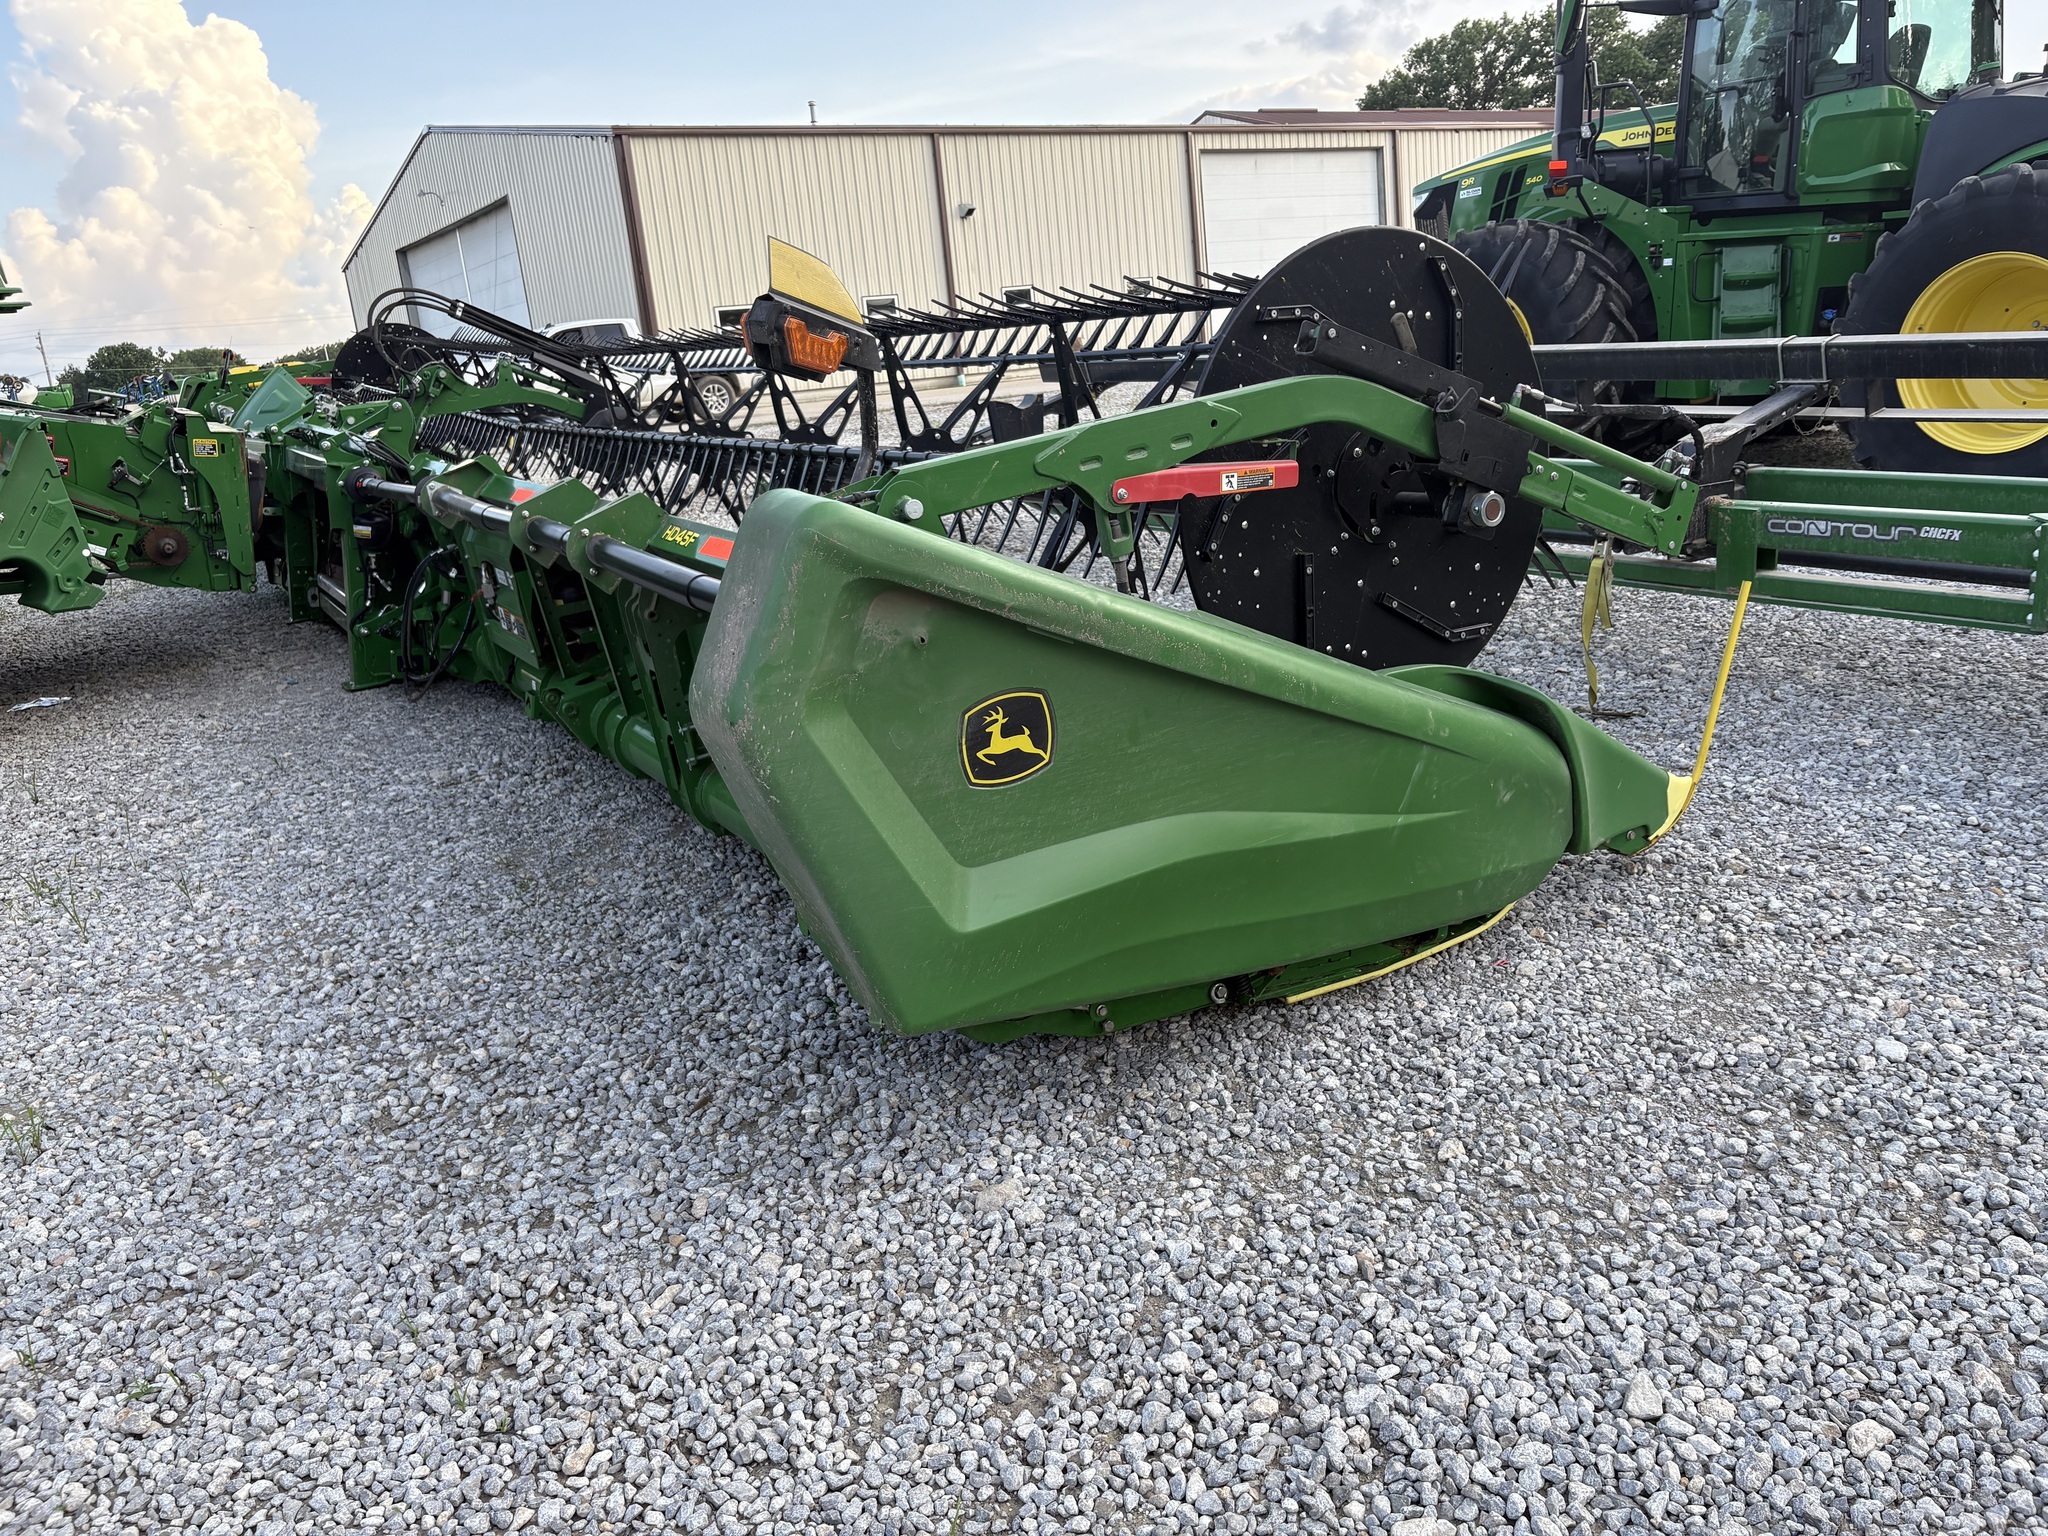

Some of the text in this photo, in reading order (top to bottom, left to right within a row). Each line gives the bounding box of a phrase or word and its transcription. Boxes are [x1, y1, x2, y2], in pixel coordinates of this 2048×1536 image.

[1622, 130, 1652, 142] JOHN
[1461, 177, 1475, 189] 9R
[1526, 175, 1543, 185] 540
[661, 524, 700, 547] HD45F
[1767, 518, 1962, 541] CONTOUR CHCFX
